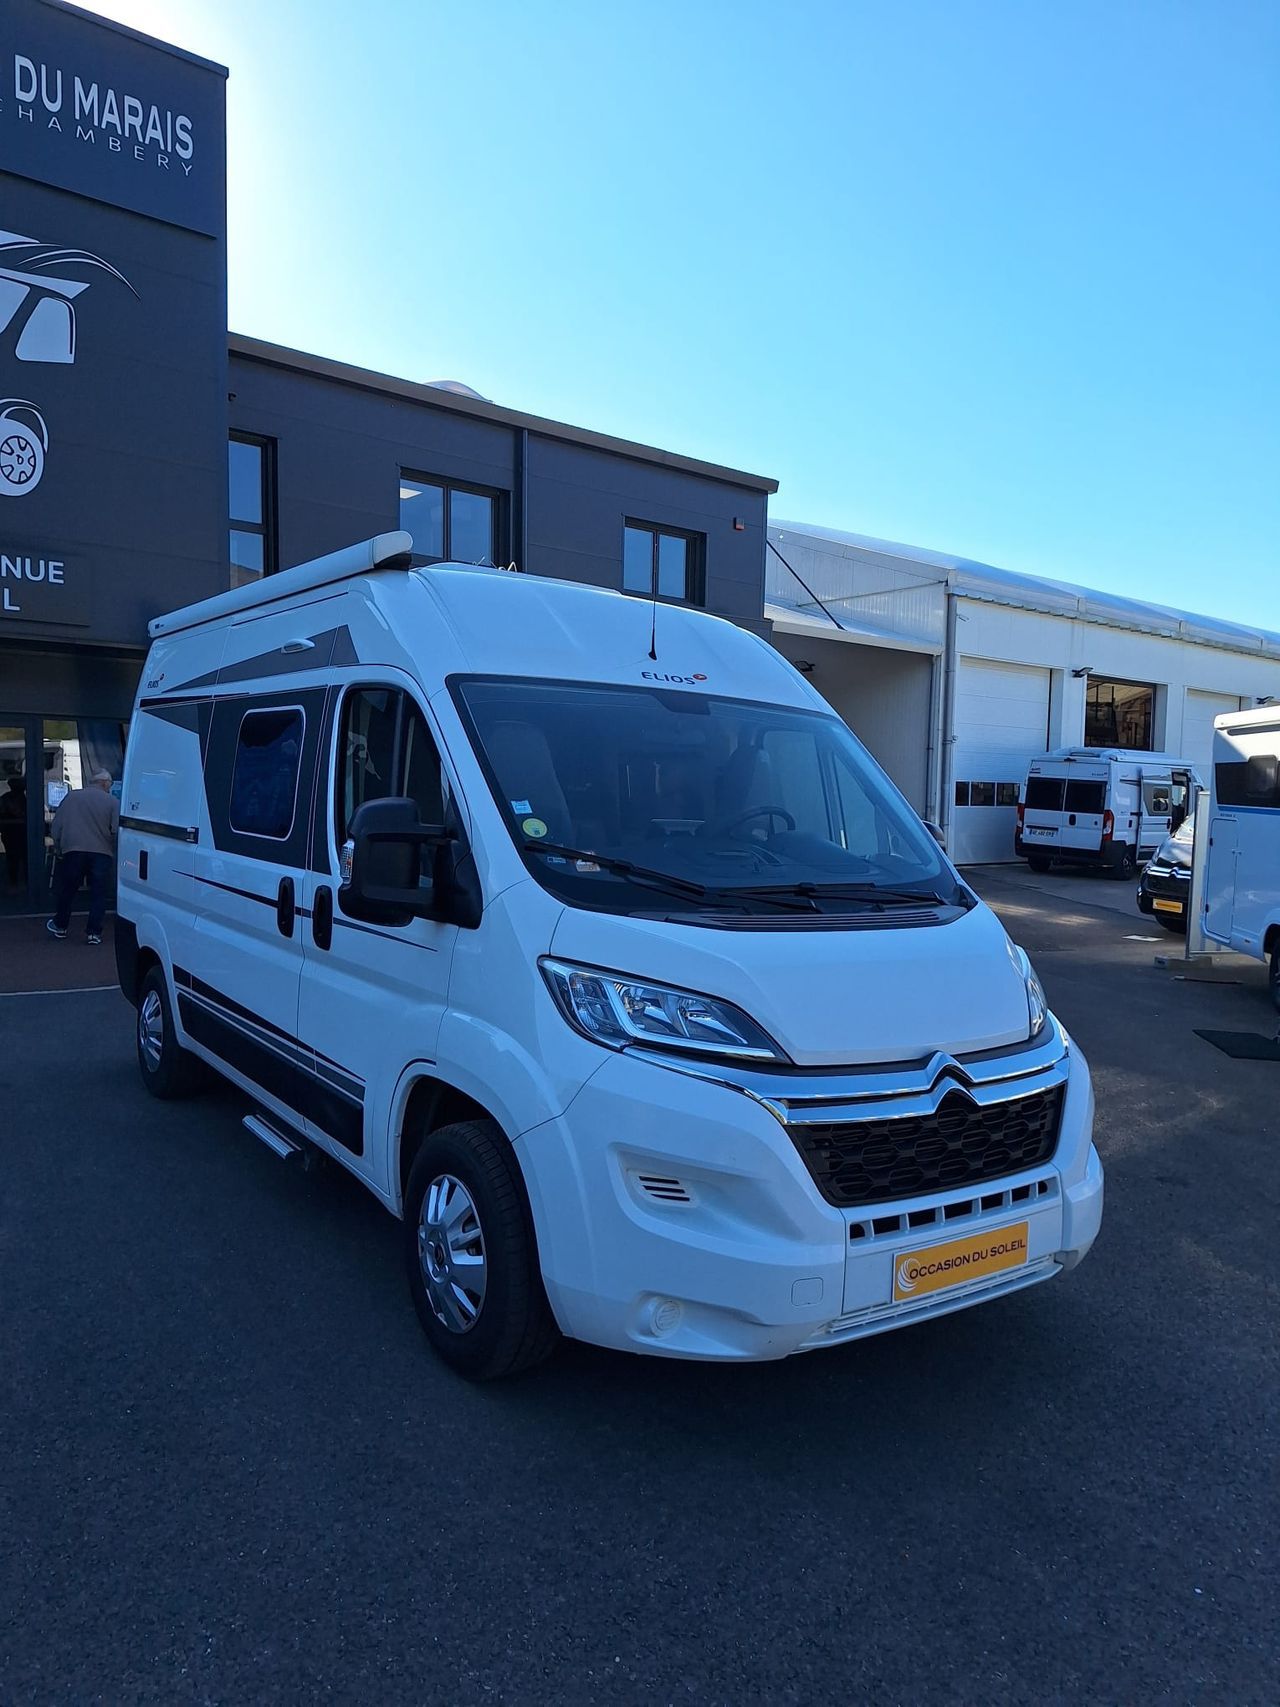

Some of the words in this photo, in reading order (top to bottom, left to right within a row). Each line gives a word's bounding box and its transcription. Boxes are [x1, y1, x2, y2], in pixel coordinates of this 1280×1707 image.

[14, 54, 62, 113] DU
[74, 76, 194, 160] MARAIS
[0, 98, 193, 177] HAMBERY
[0, 555, 65, 585] NUE
[3, 587, 21, 611] L
[641, 671, 696, 686] ELIOS
[909, 1254, 971, 1280] OCCASION
[972, 1249, 988, 1263] DU
[990, 1239, 1026, 1257] SOLEIL
